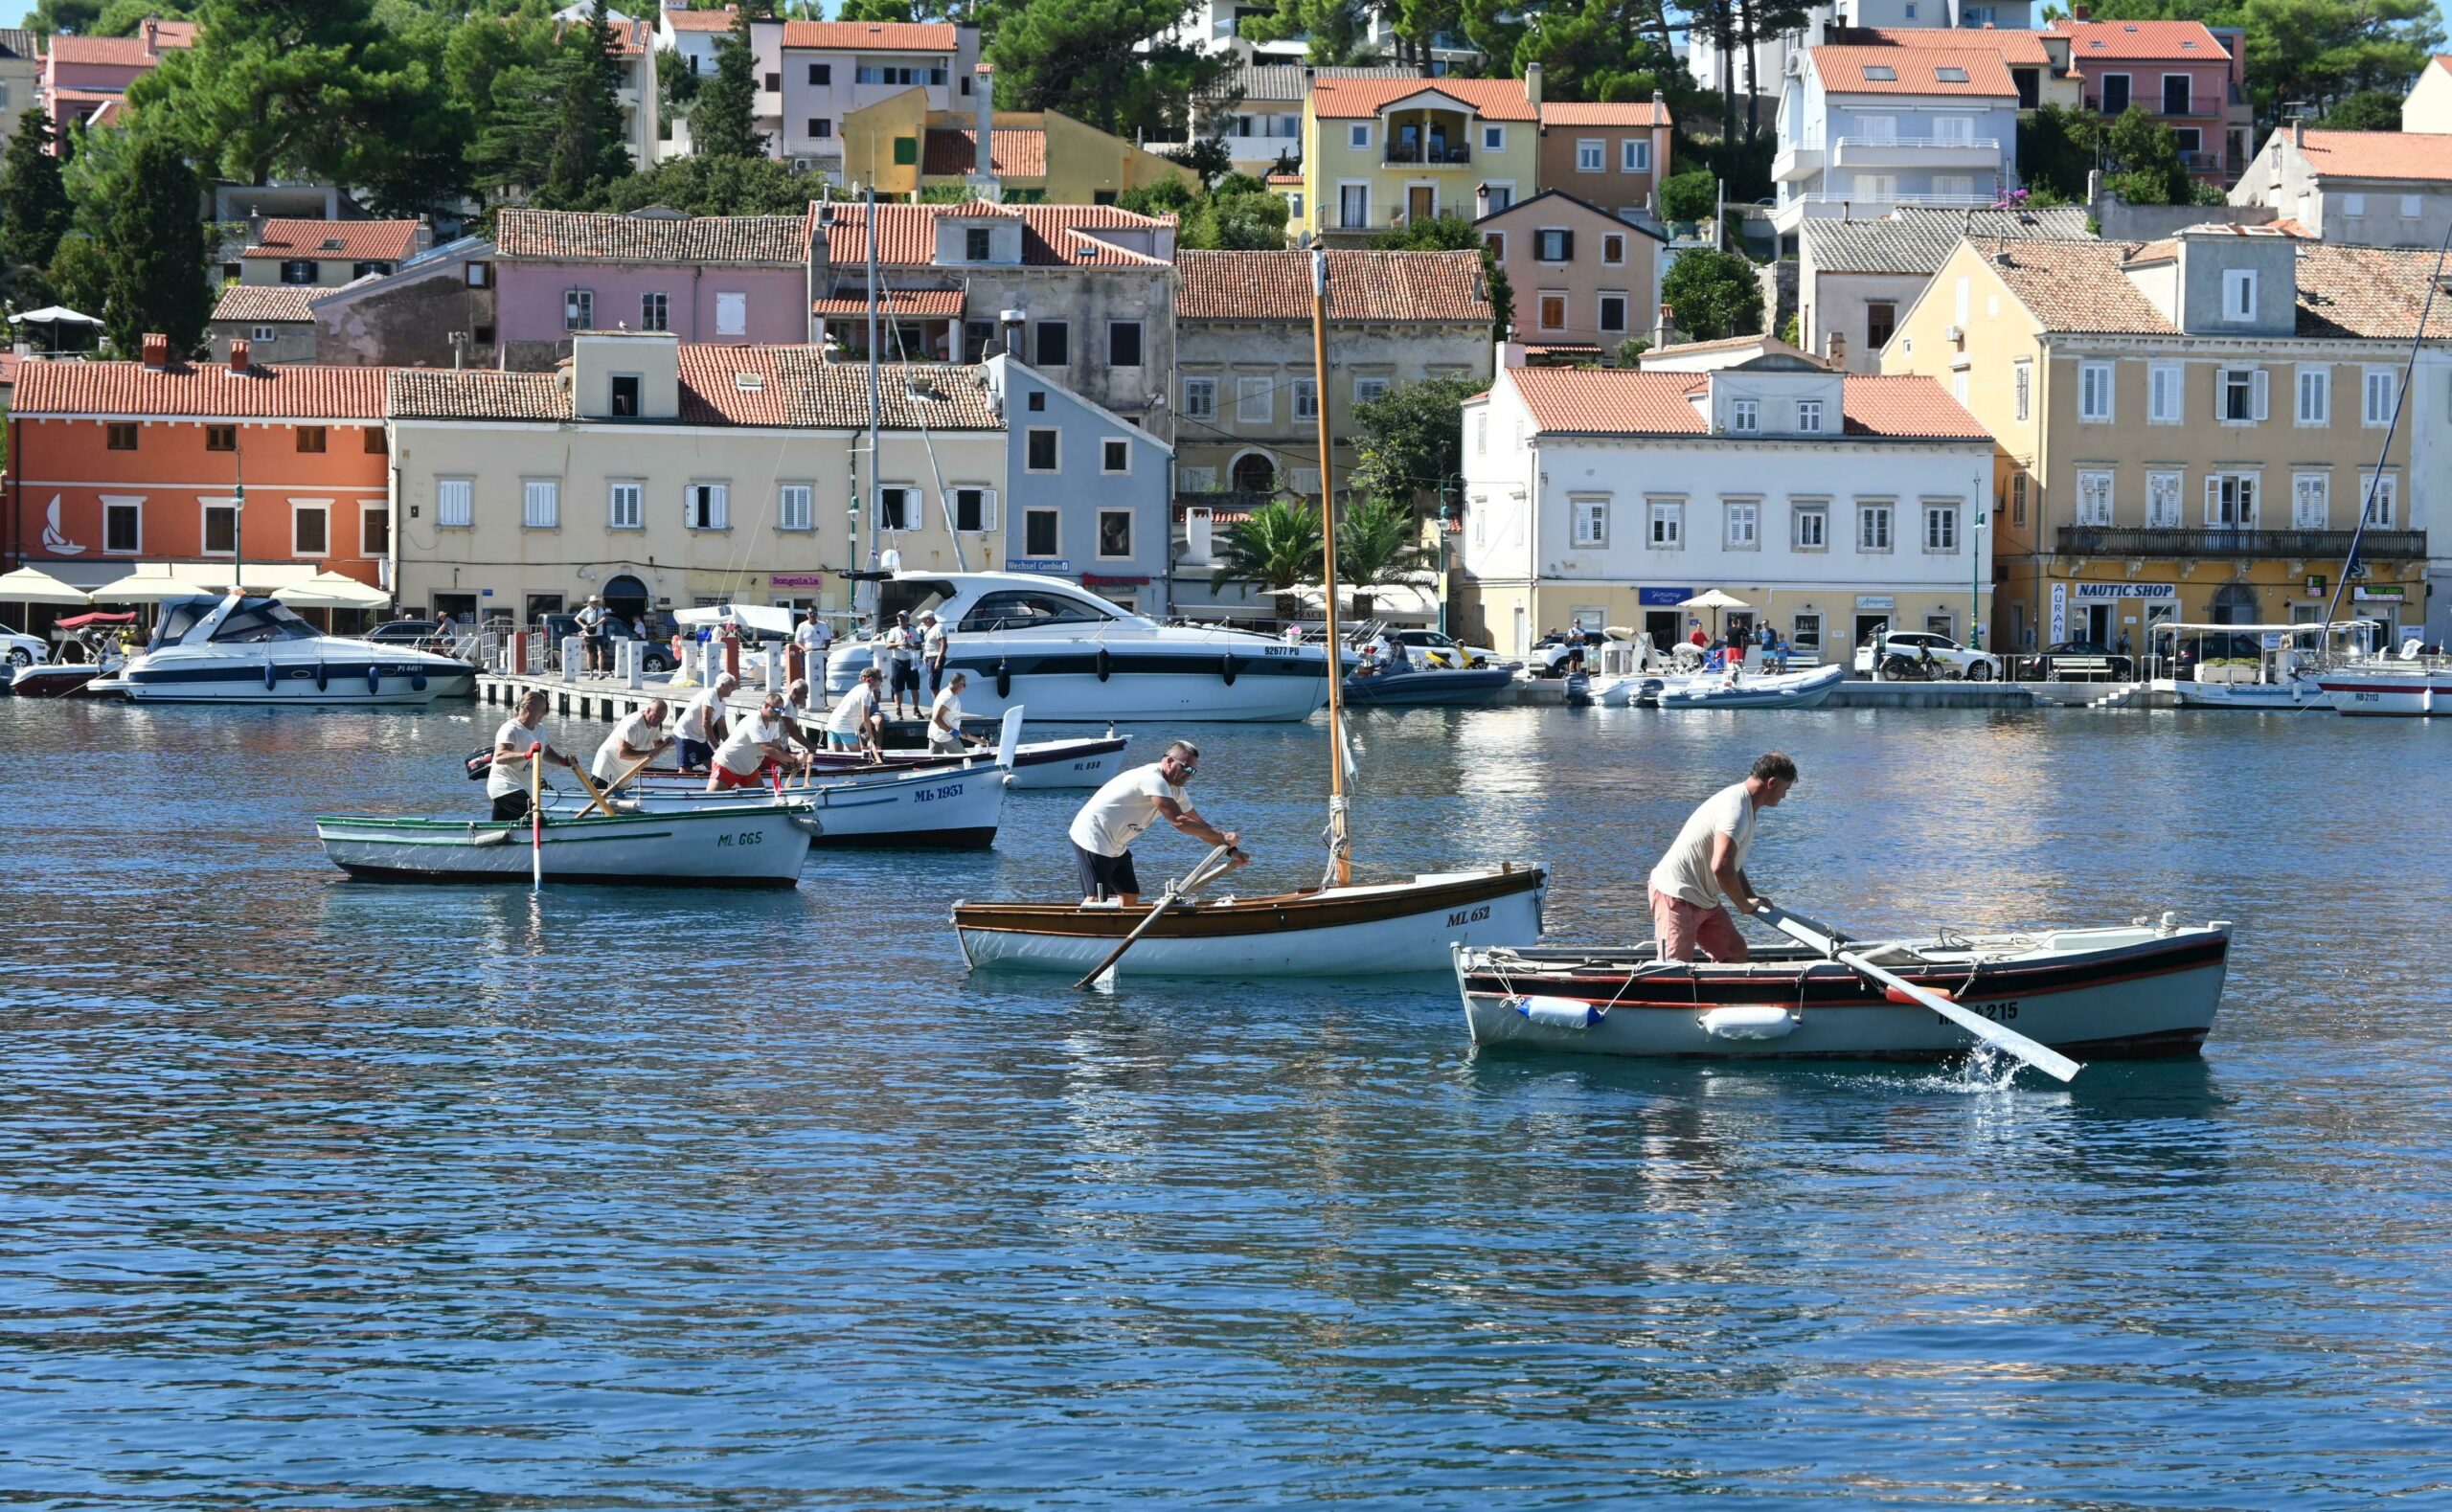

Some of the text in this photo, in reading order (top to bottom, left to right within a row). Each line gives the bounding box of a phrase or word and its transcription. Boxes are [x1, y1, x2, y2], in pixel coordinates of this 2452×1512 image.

[1007, 561, 1062, 571] Wechsel Cambio
[772, 576, 819, 587] Bongolala
[2078, 584, 2173, 598] NAUTIC SHOP
[1264, 645, 1300, 657] 92677 PU
[2355, 692, 2379, 702] RB 2113
[1073, 762, 1084, 772] ML
[914, 782, 964, 803] ML 1931
[717, 833, 734, 847] ML
[1446, 905, 1490, 928] ML 652
